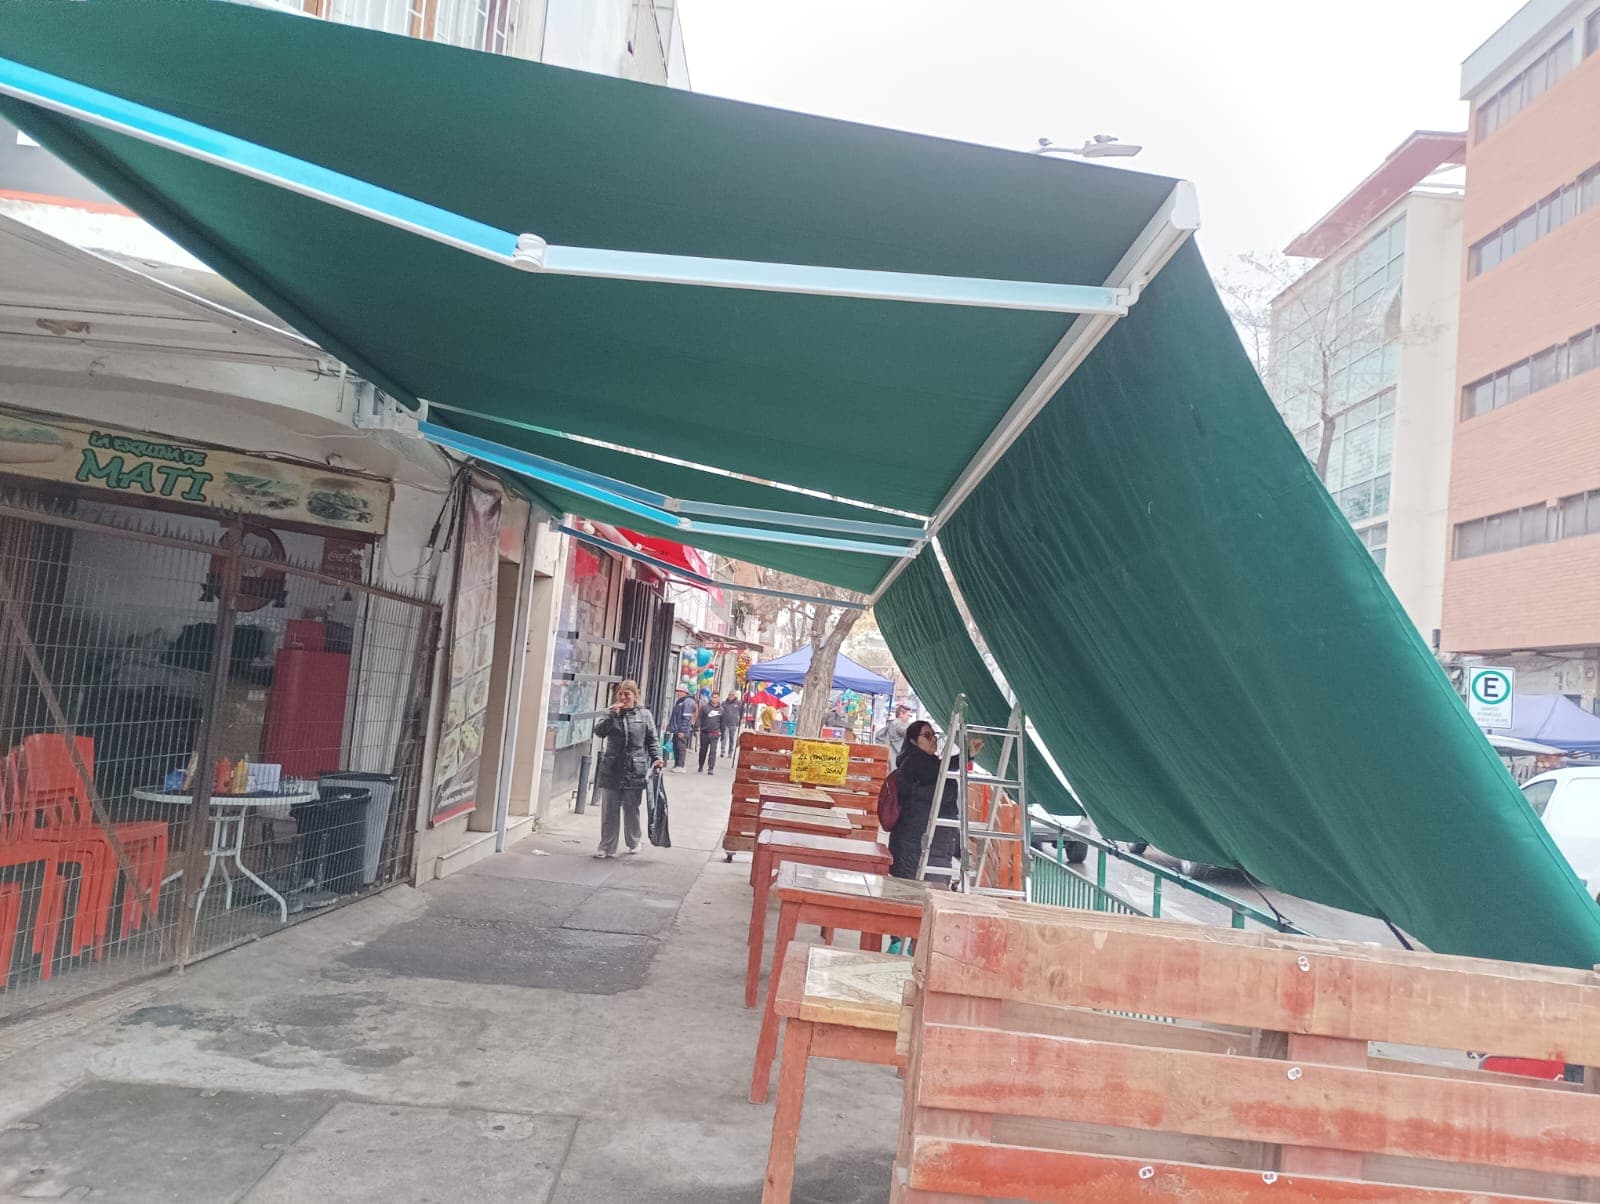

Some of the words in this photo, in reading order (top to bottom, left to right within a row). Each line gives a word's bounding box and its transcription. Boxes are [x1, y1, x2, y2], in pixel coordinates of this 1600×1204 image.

[89, 431, 112, 449] LA
[181, 450, 208, 467] DE
[75, 448, 214, 501] MATI
[1484, 677, 1498, 697] E
